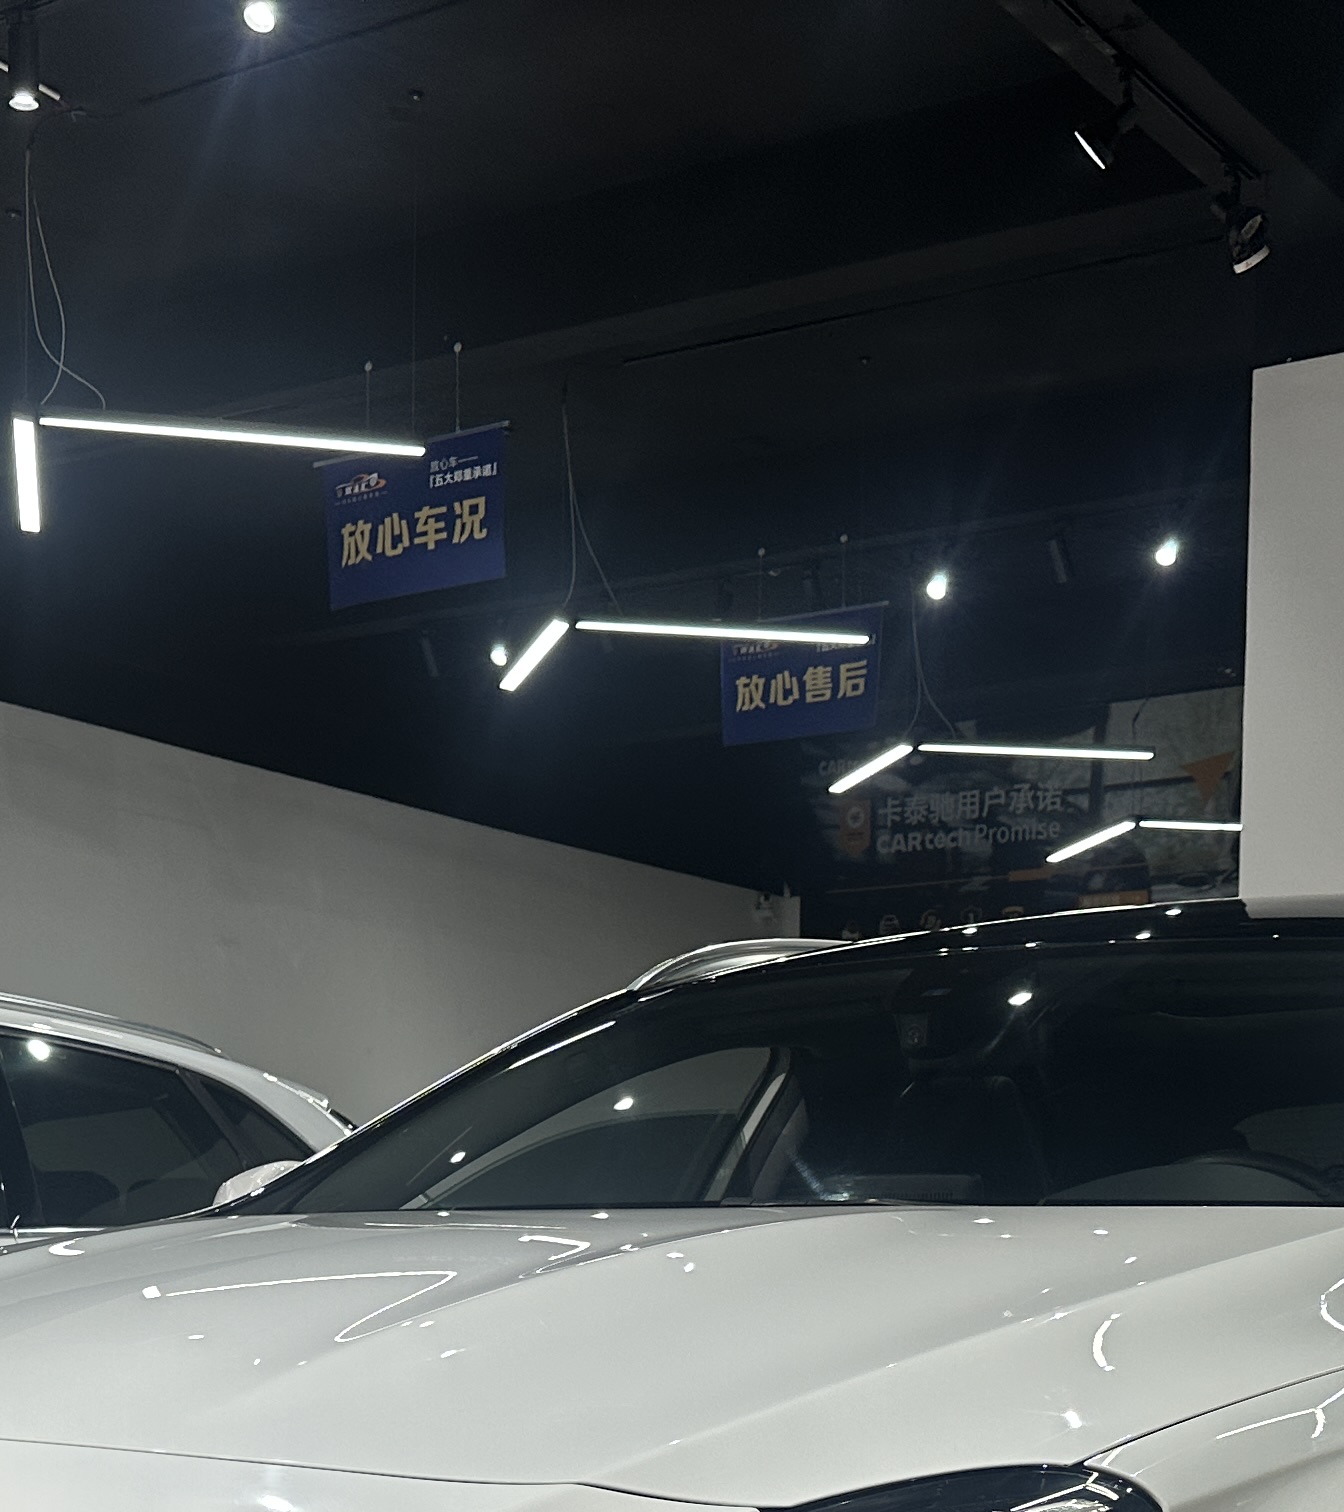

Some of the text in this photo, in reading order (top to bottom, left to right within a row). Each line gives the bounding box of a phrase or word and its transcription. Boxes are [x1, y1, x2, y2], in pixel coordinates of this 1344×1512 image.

[340, 496, 488, 568] 放心车况
[735, 659, 868, 713] 放心售后
[878, 782, 1067, 828] 卡泰驰用户承诺
[975, 819, 1061, 850] Promise
